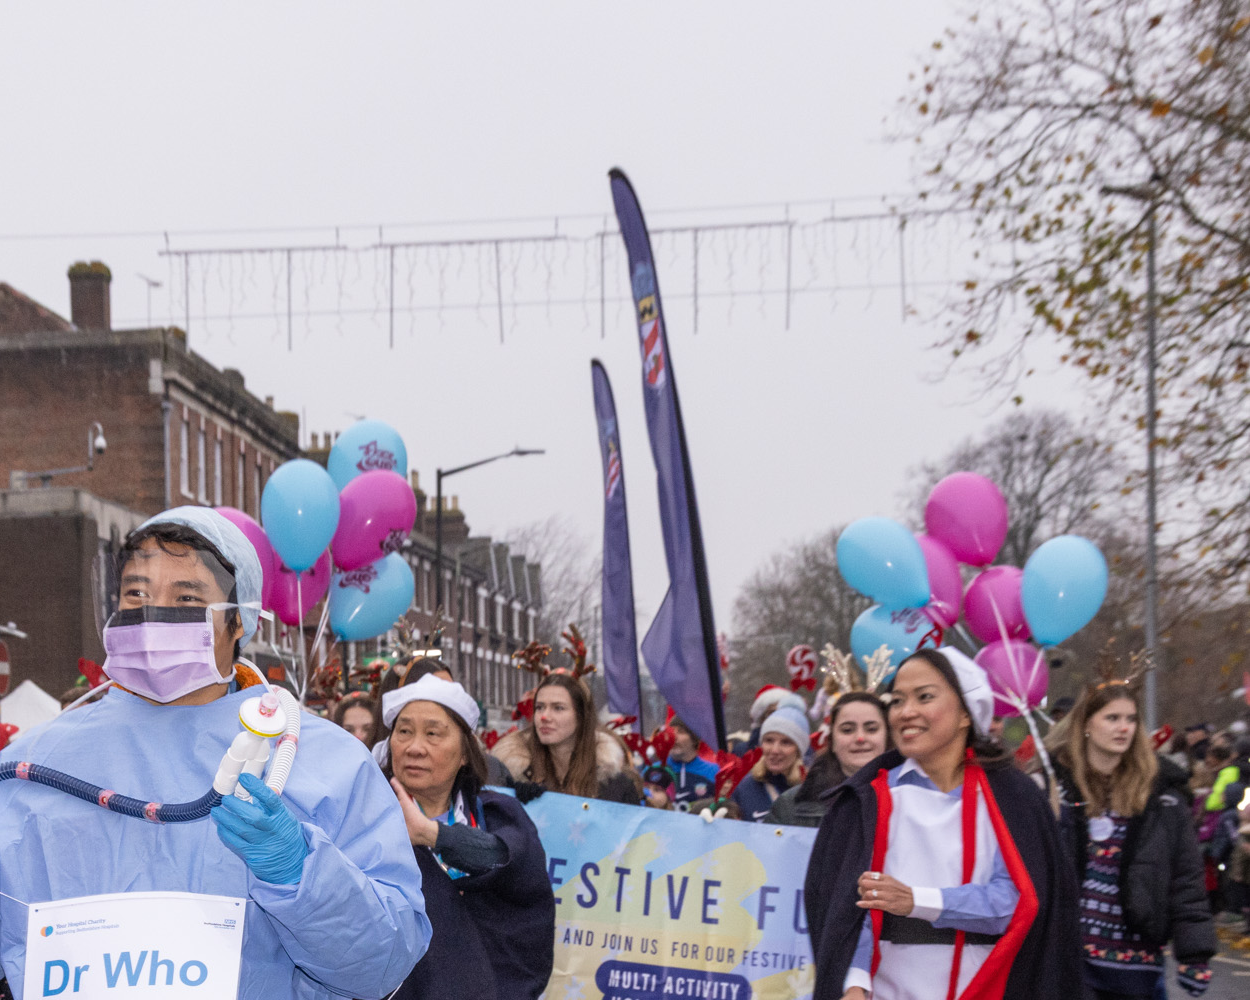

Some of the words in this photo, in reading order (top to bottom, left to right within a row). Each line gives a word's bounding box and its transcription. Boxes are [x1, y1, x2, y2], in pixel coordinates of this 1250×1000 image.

[563, 927, 594, 946] AND
[601, 932, 633, 952] JOIN
[641, 938, 658, 955] US
[671, 941, 699, 960] FOR
[705, 945, 735, 964] OUR
[741, 950, 807, 971] FESTIVE
[43, 959, 90, 997] Dr
[103, 950, 208, 988] Who
[608, 969, 657, 992] MULTI
[663, 976, 741, 1000] ACTIVITY
